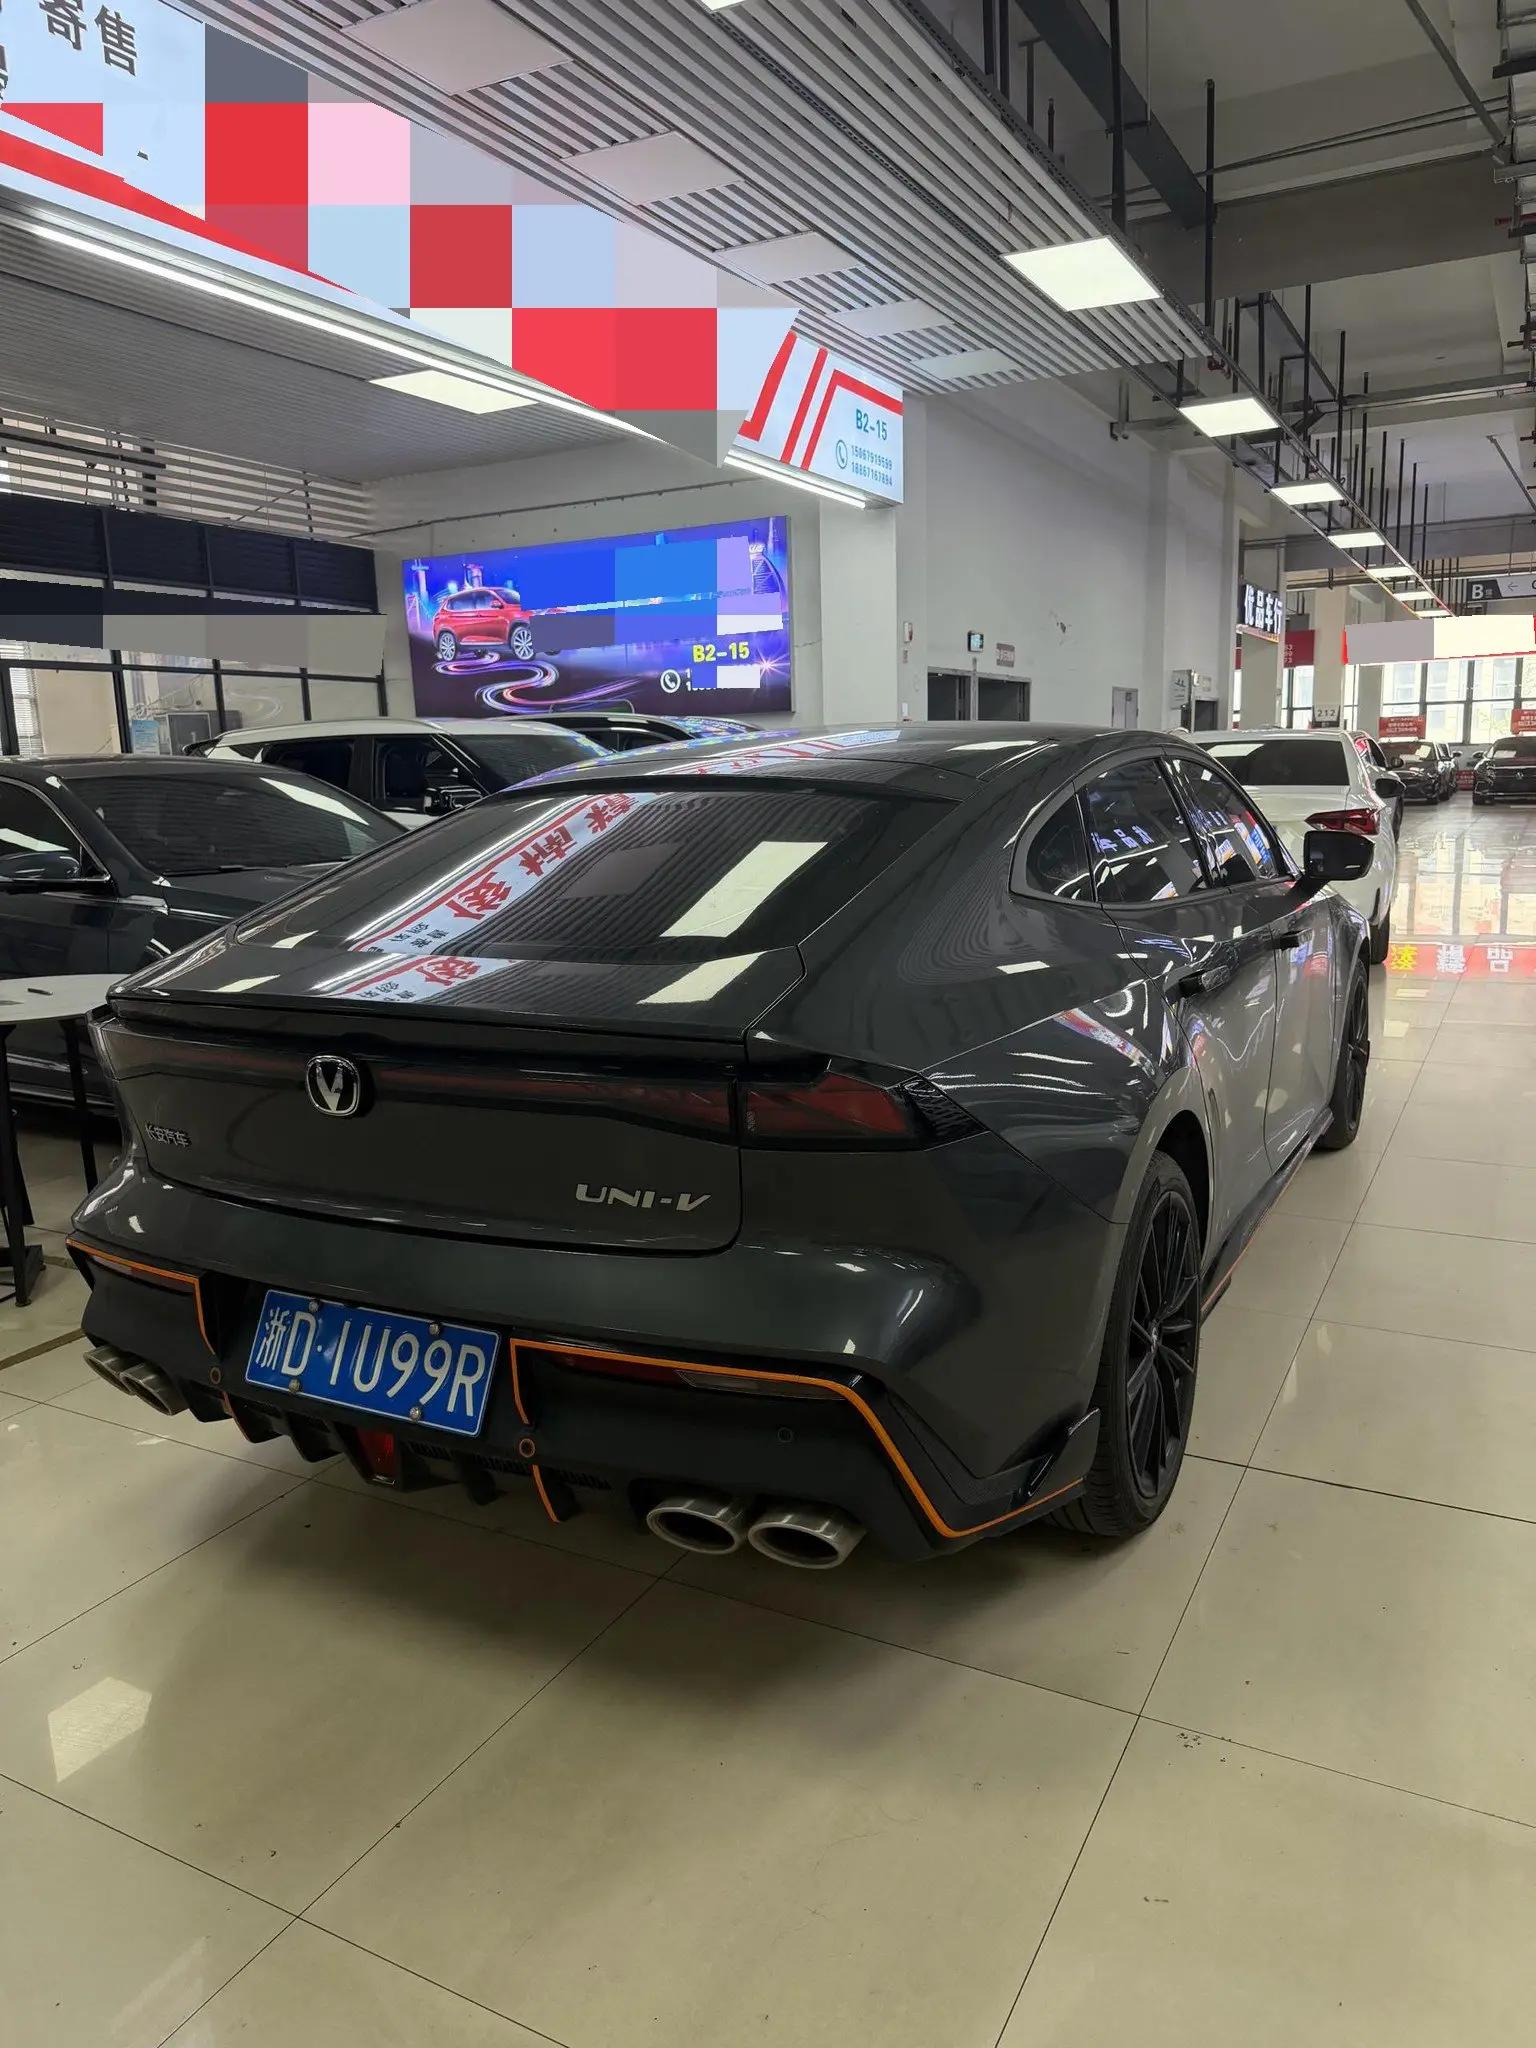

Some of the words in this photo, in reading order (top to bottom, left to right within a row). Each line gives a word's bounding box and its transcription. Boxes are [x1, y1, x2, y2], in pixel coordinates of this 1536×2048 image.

[856, 409, 887, 441] B2-15
[692, 642, 750, 663] B2-15
[575, 1183, 711, 1213] UNI-V
